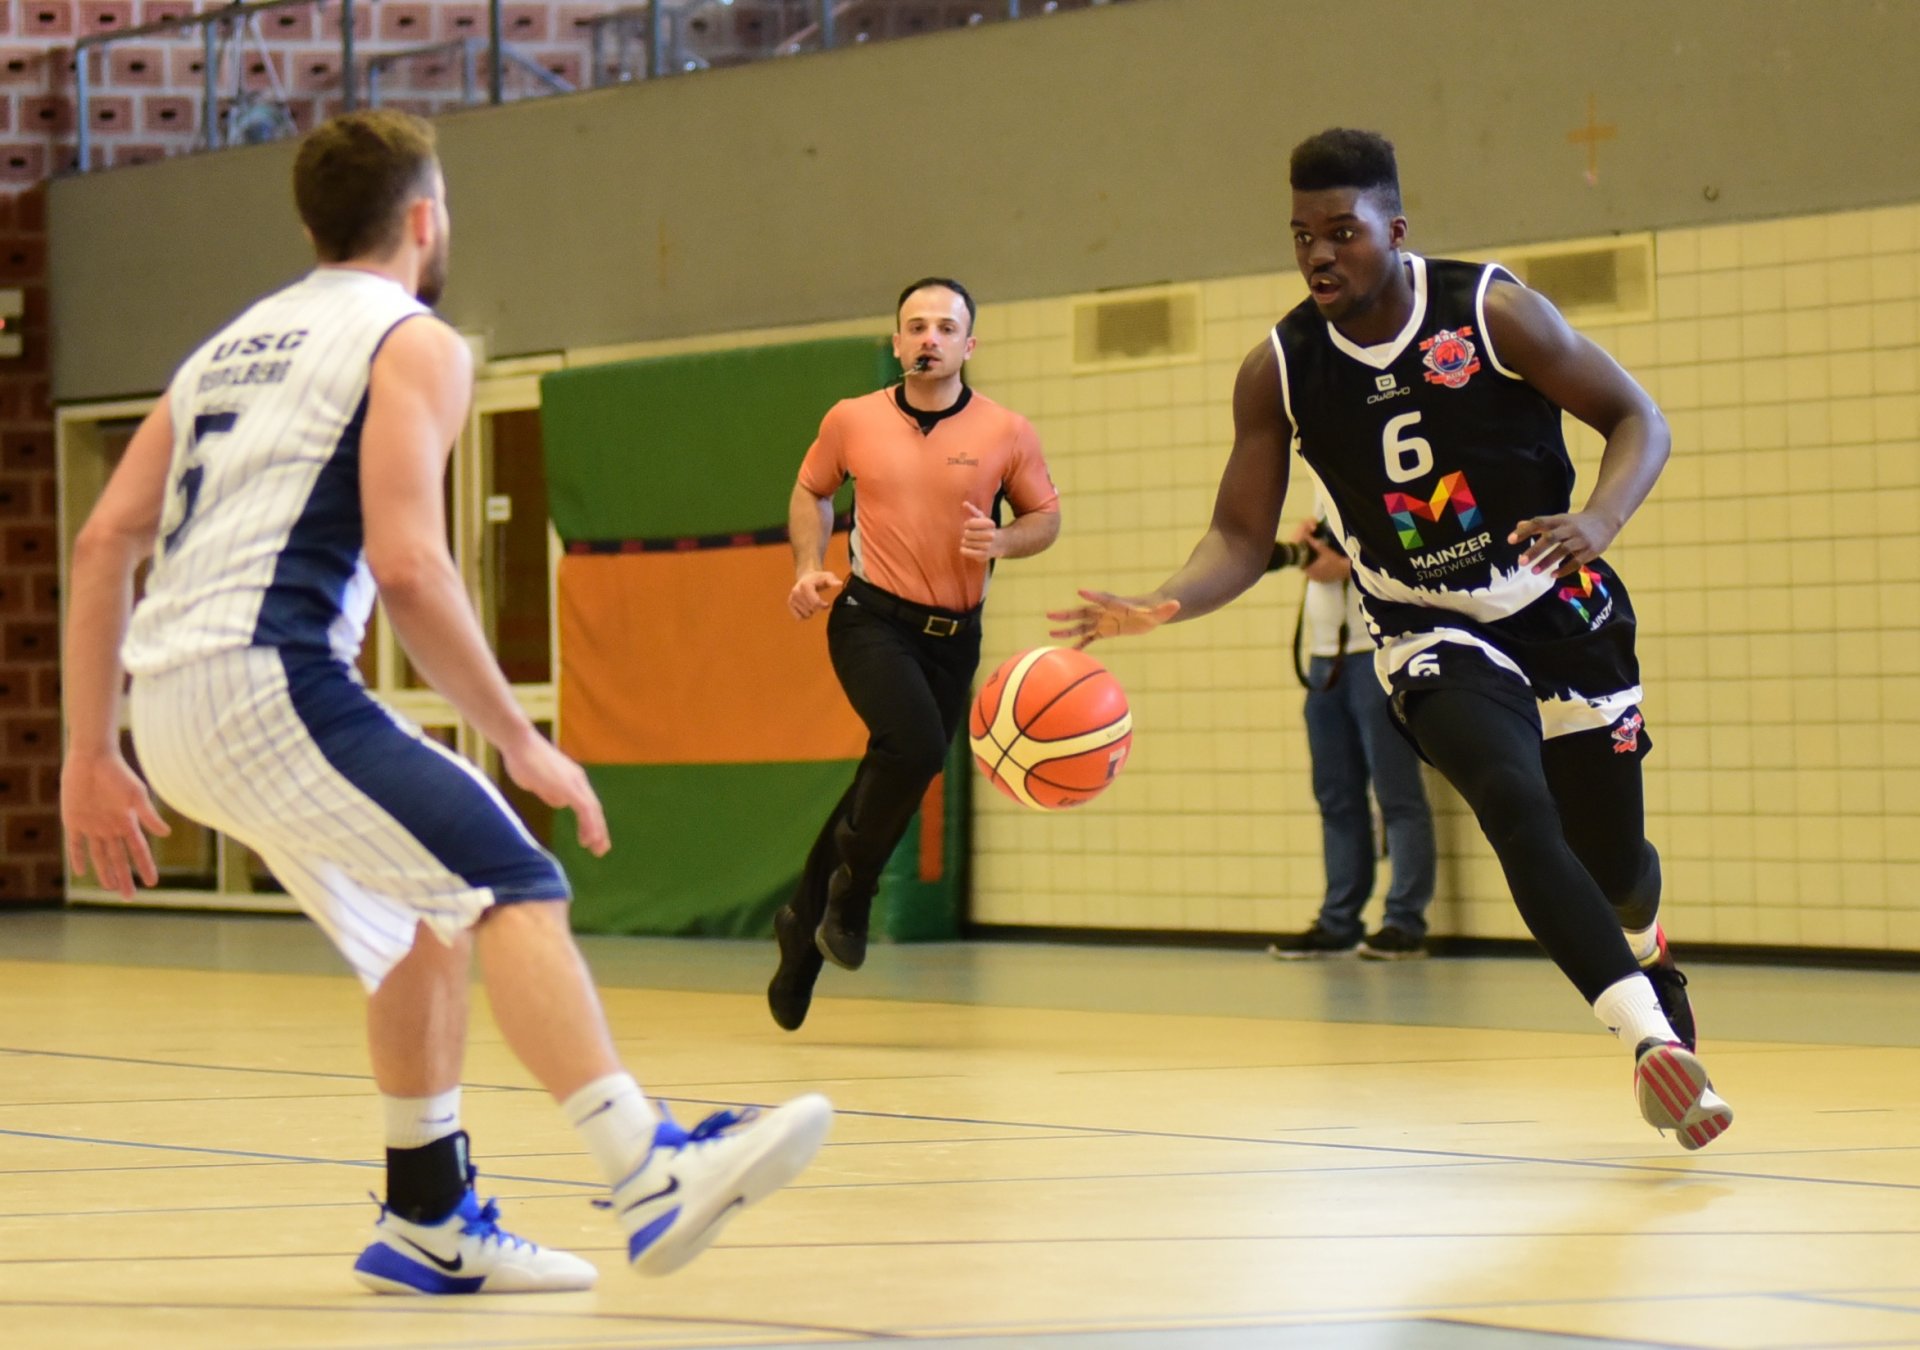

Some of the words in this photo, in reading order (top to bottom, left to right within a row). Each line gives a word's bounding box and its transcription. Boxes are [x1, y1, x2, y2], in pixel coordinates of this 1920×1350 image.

[212, 330, 308, 361] USG
[1382, 410, 1434, 484] 6
[164, 411, 239, 554] 5
[1409, 531, 1492, 569] MAINZER
[1416, 552, 1486, 581] STADTWERKE
